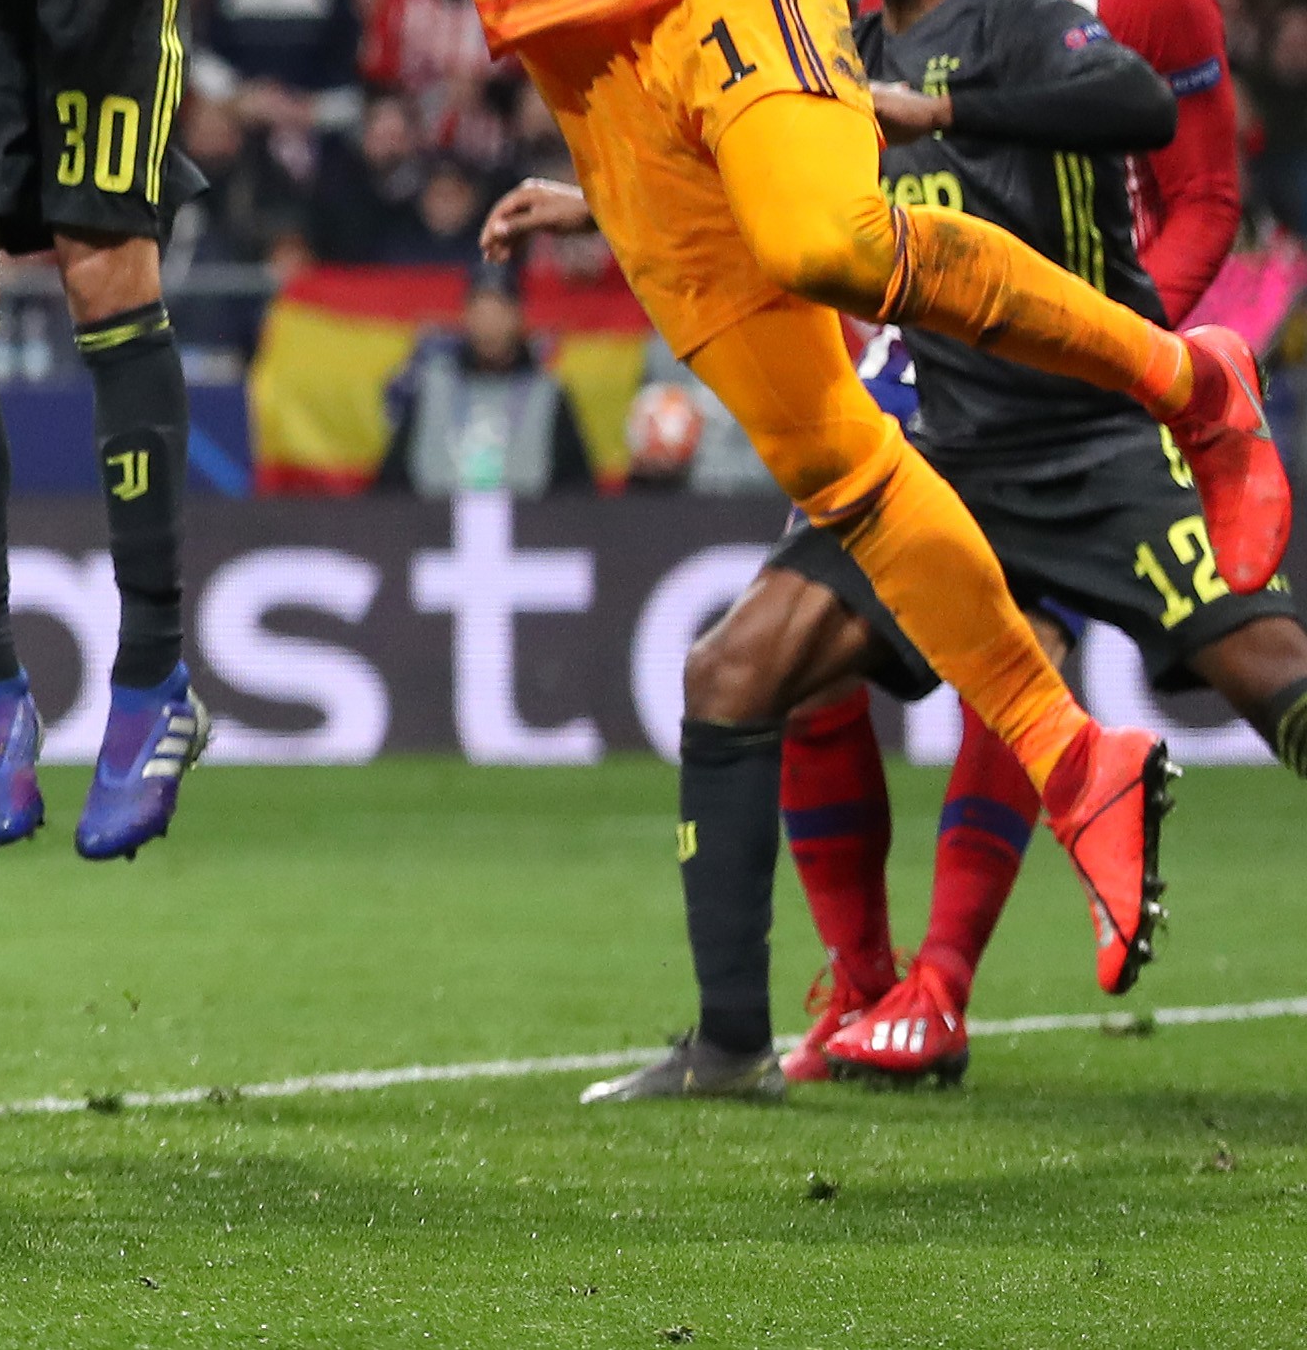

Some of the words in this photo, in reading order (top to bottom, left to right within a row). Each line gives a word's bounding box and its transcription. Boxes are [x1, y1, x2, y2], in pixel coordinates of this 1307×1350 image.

[701, 17, 757, 92] 1
[55, 90, 140, 193] 30
[1133, 515, 1230, 631] 12
